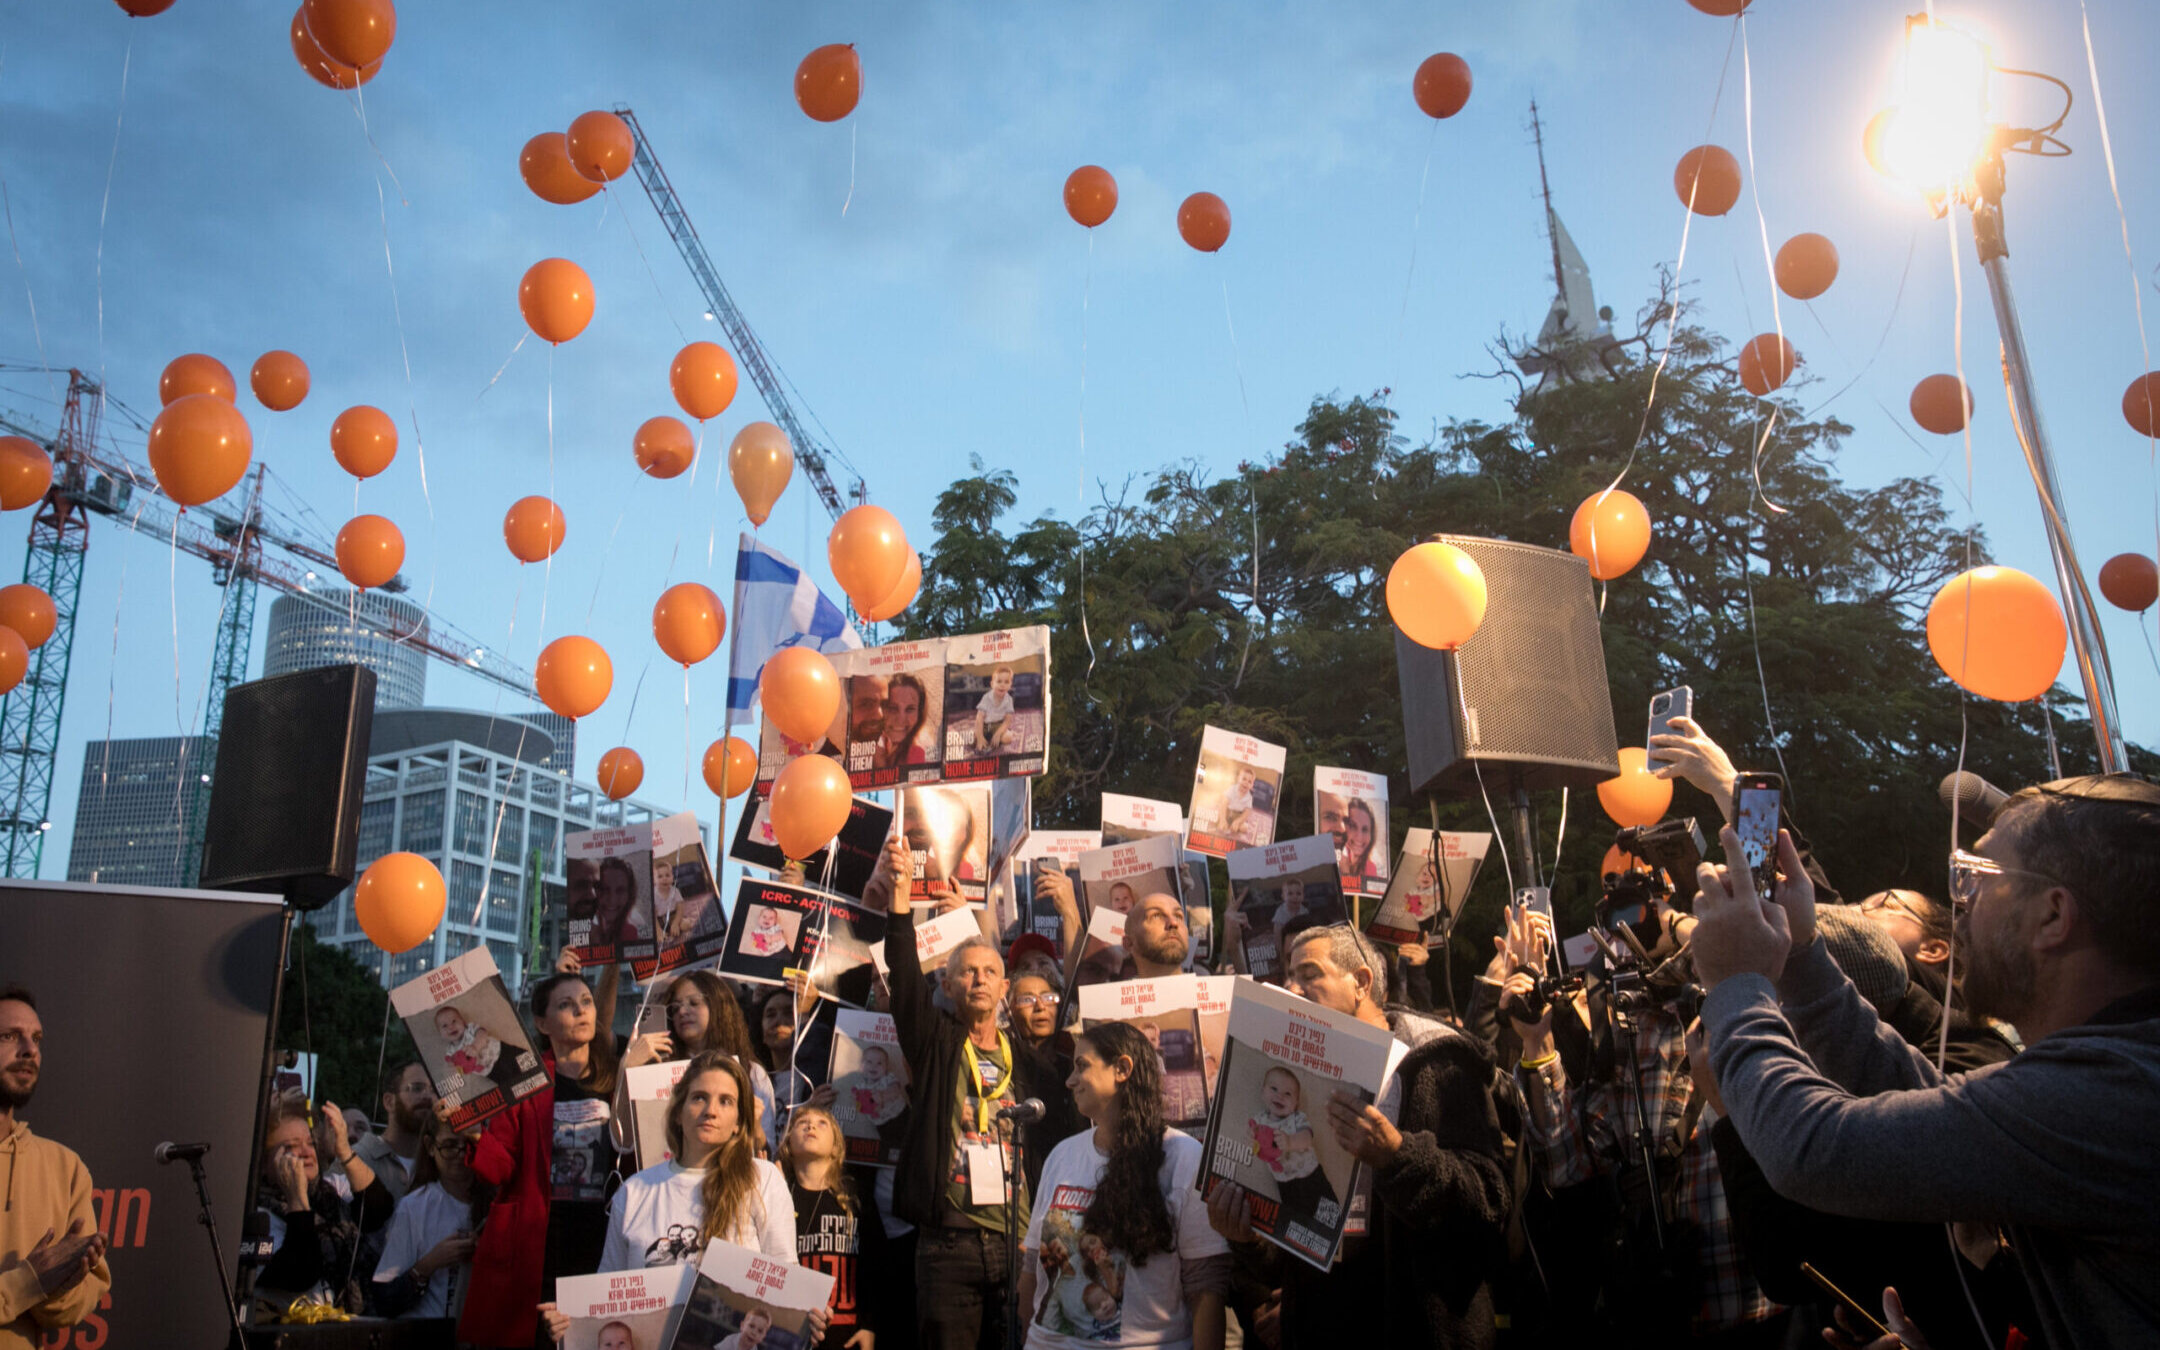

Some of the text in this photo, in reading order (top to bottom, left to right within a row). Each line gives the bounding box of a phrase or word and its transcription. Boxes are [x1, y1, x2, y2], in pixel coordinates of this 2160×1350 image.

[850, 740, 876, 756] BRING
[946, 745, 964, 761] HIM
[760, 752, 784, 765] BRING
[850, 756, 872, 770] THEM
[946, 761, 972, 777] HOME
[974, 756, 1000, 774] NOW!
[758, 766, 776, 781] HIM
[850, 772, 872, 787] HOME
[874, 767, 899, 784] NOW!
[762, 890, 792, 904] ICRC
[800, 898, 826, 912] ACT
[830, 905, 860, 922] NOW!
[569, 920, 591, 933] BRING
[1034, 916, 1058, 928] BRING
[570, 934, 590, 946] THEM
[575, 946, 591, 960] OME
[592, 944, 616, 960] NOW!
[661, 944, 688, 965] NOW!
[1248, 945, 1277, 961] BRING
[1251, 962, 1270, 978] HIM
[1120, 994, 1156, 1006] ARIEL BIBAS
[1289, 1021, 1326, 1044] כפיר ביבס
[1284, 1034, 1326, 1058] KFIR BIBAS
[1291, 1050, 1301, 1063] 10
[436, 1073, 464, 1097] BRING
[450, 1088, 505, 1126] HOME NOW!
[1216, 1134, 1253, 1167] BRING
[1212, 1156, 1237, 1180] HIM
[798, 1233, 833, 1253] הביתה
[752, 1257, 788, 1278] אריאל ביבס
[610, 1275, 644, 1289] כפיר ביבס
[746, 1269, 784, 1290] ARIEL BIBAS
[608, 1287, 646, 1301] KFIR BIBAS
[756, 1284, 766, 1298] (4)
[620, 1301, 628, 1312] 10
